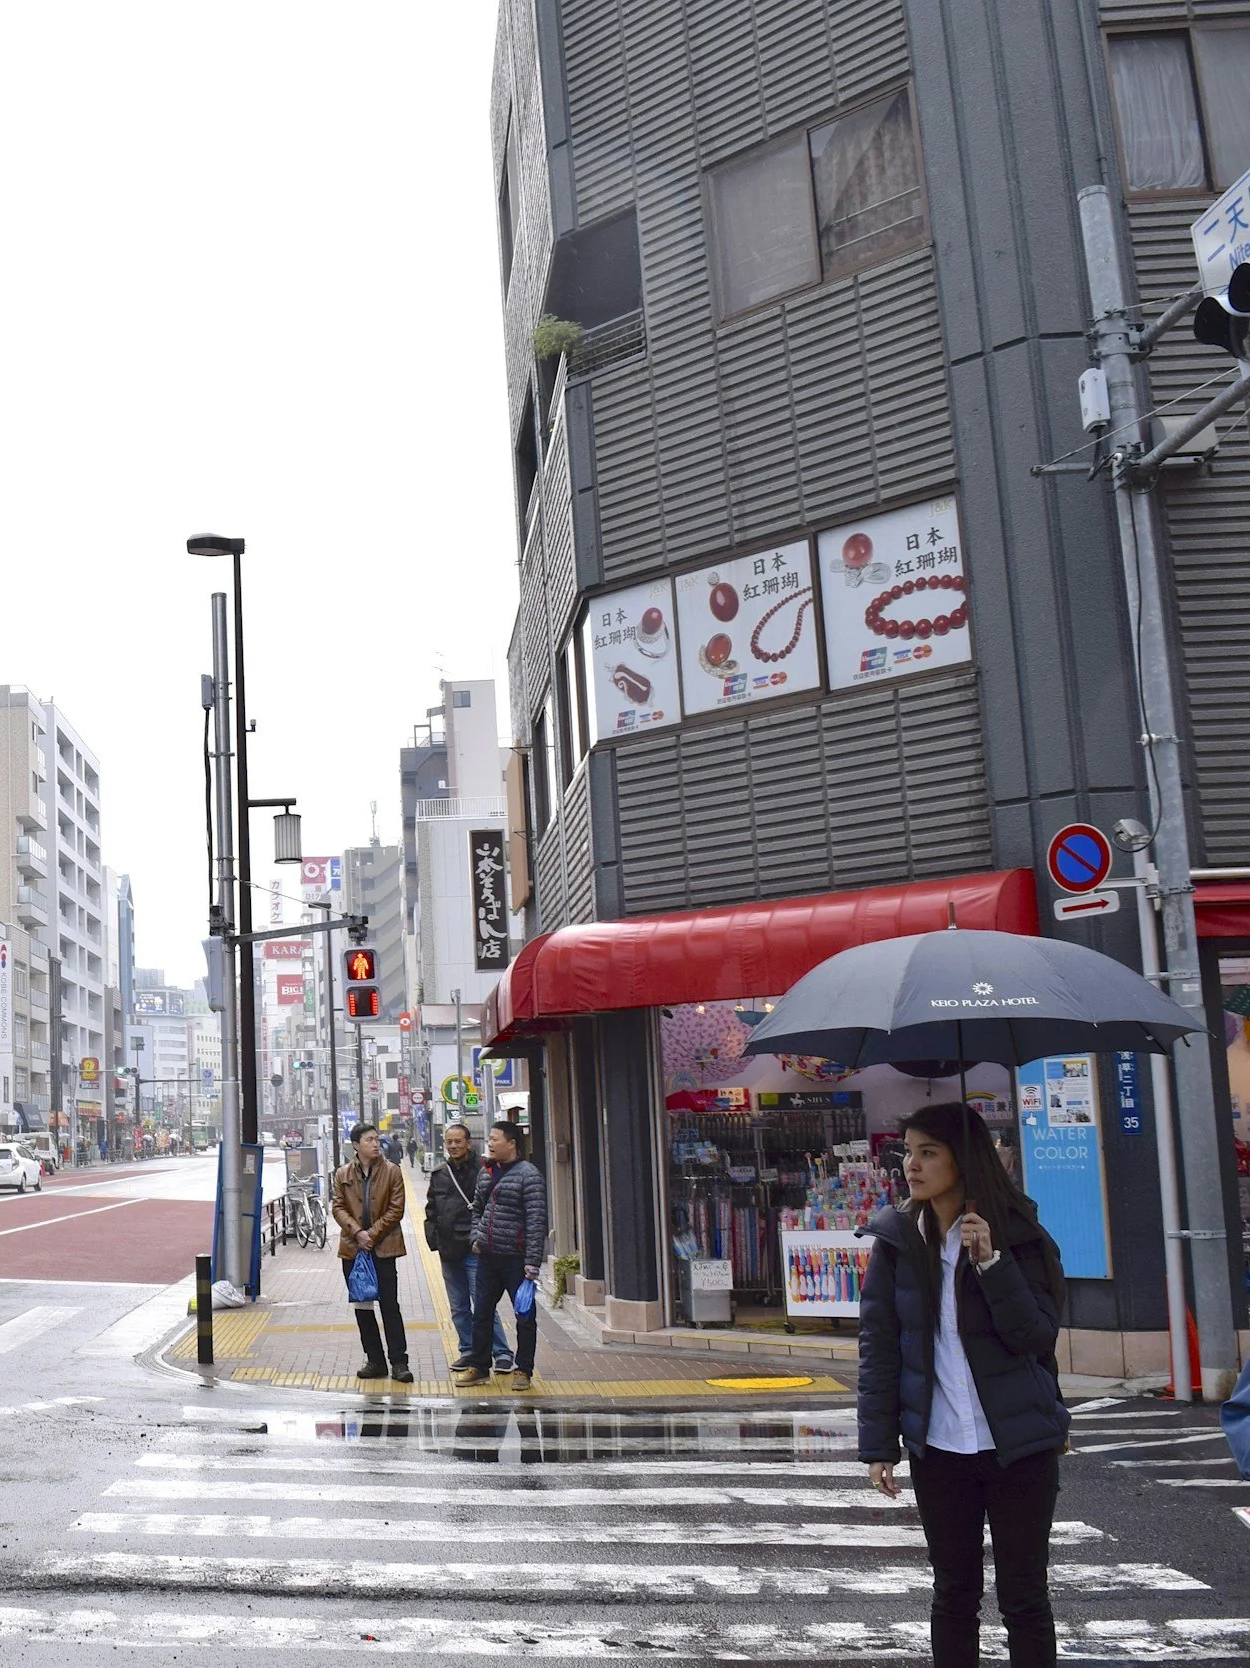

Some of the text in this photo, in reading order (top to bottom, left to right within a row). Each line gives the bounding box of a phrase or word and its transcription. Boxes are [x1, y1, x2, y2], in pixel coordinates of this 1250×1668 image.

[1203, 190, 1250, 263] 二天
[906, 526, 945, 551] 日本
[753, 552, 788, 576] 日本
[894, 546, 958, 578] 紅珊瑚
[742, 571, 799, 602] 紅珊瑚
[601, 607, 628, 628] 日本
[593, 626, 637, 650] 紅珊瑚
[475, 842, 507, 960] 山本そろばん店
[930, 996, 1040, 1007] KEIO PLAZA HOTEL
[1032, 1127, 1087, 1141] WATER
[1123, 1116, 1140, 1129] 35
[1033, 1146, 1088, 1160] COLOR
